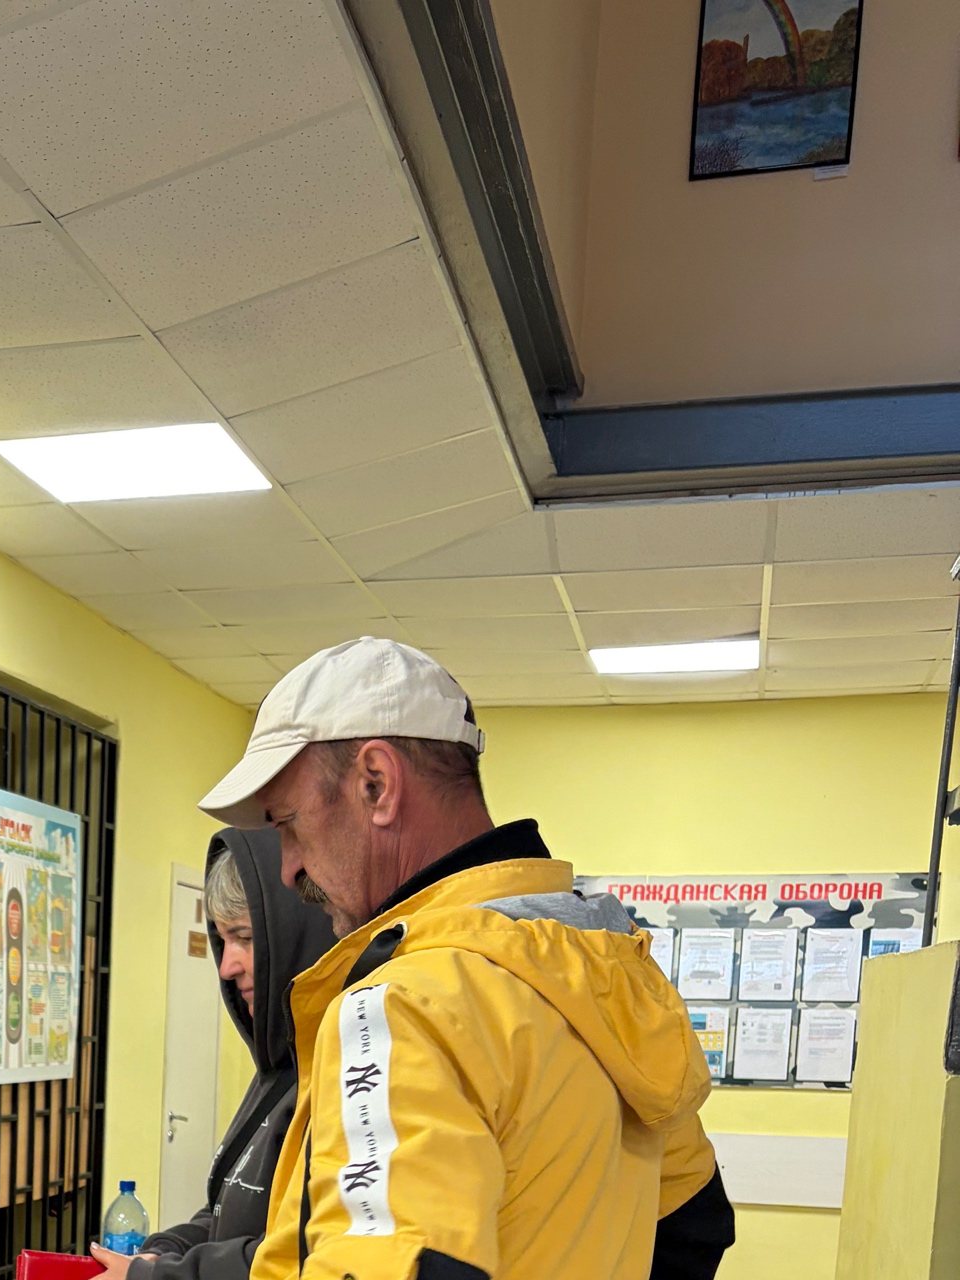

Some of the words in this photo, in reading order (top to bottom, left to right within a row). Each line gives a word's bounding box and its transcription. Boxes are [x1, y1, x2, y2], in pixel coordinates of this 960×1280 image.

[607, 883, 767, 904] ГРАЖДАНСКАЯ
[780, 882, 883, 901] ОБОРОНА
[356, 999, 367, 1020] NEW
[359, 1026, 371, 1056] YORK
[359, 1104, 371, 1126] NEW
[360, 1200, 376, 1221] NEW
